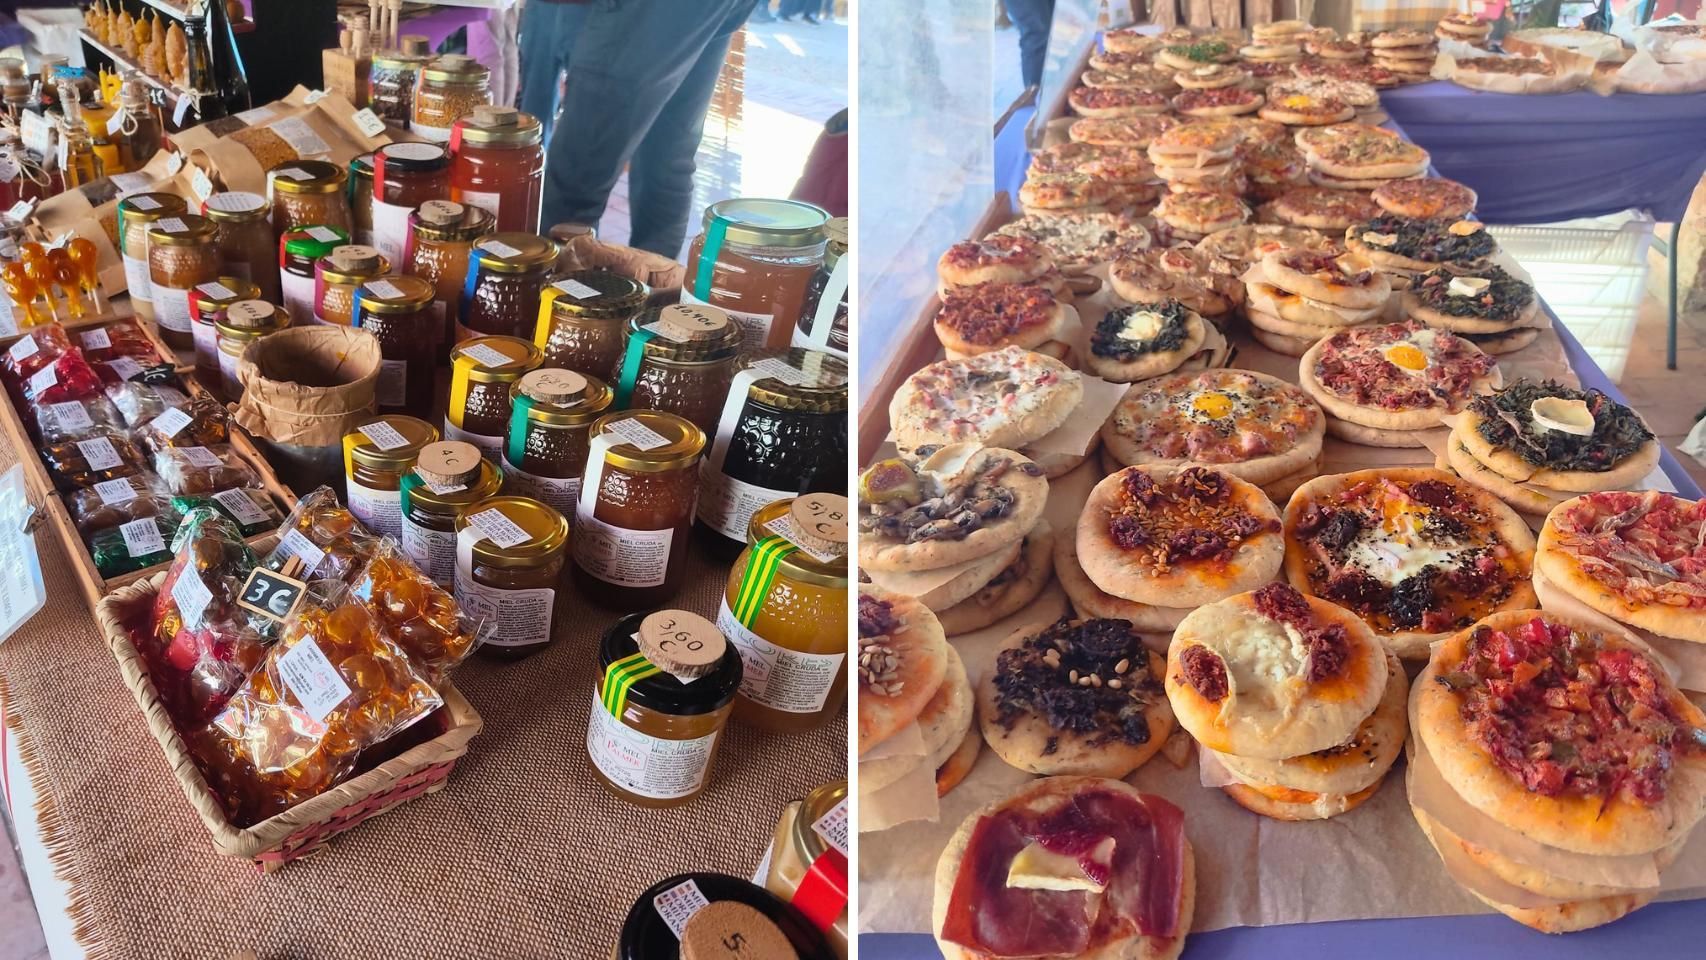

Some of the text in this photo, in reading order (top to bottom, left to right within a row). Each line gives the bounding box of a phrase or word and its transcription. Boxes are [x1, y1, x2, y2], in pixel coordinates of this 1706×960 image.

[478, 602, 494, 611] MEL
[659, 619, 703, 652] 3,60
[748, 656, 766, 670] MEL
[776, 660, 820, 672] MIEL CRUDA
[607, 740, 642, 768] PALMER
[623, 746, 641, 759] MEL
[651, 748, 698, 756] MIEL CRUDA
